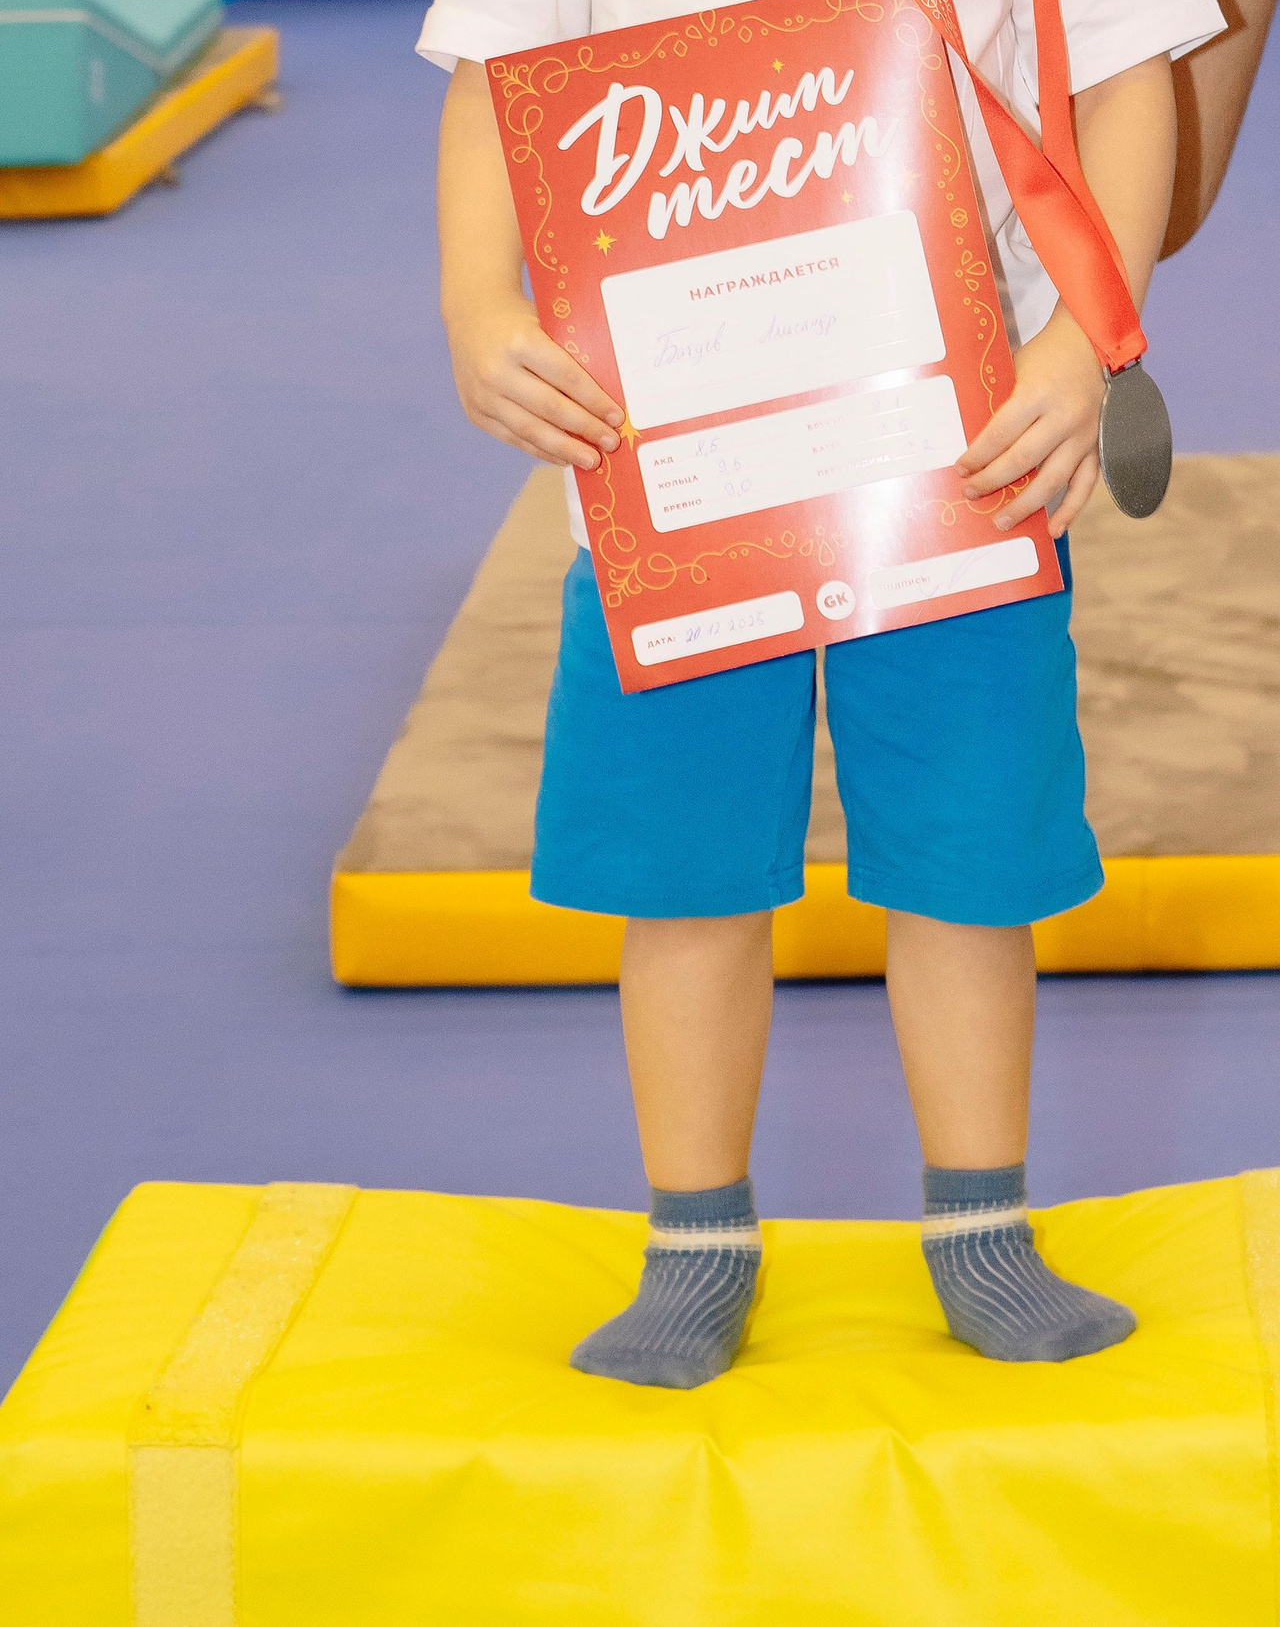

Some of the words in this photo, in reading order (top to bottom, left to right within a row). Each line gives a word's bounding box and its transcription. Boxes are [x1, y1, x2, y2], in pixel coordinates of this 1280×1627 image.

[557, 66, 855, 216] Джим
[647, 115, 901, 240] тест
[689, 256, 841, 302] НАГРАЖДАЕТСЯ
[653, 456, 675, 467] АКД
[657, 474, 699, 490] КОЛЬЦА
[663, 498, 703, 513] БРЕВНО
[823, 591, 849, 609] GK
[647, 636, 676, 649] ДАТА:
